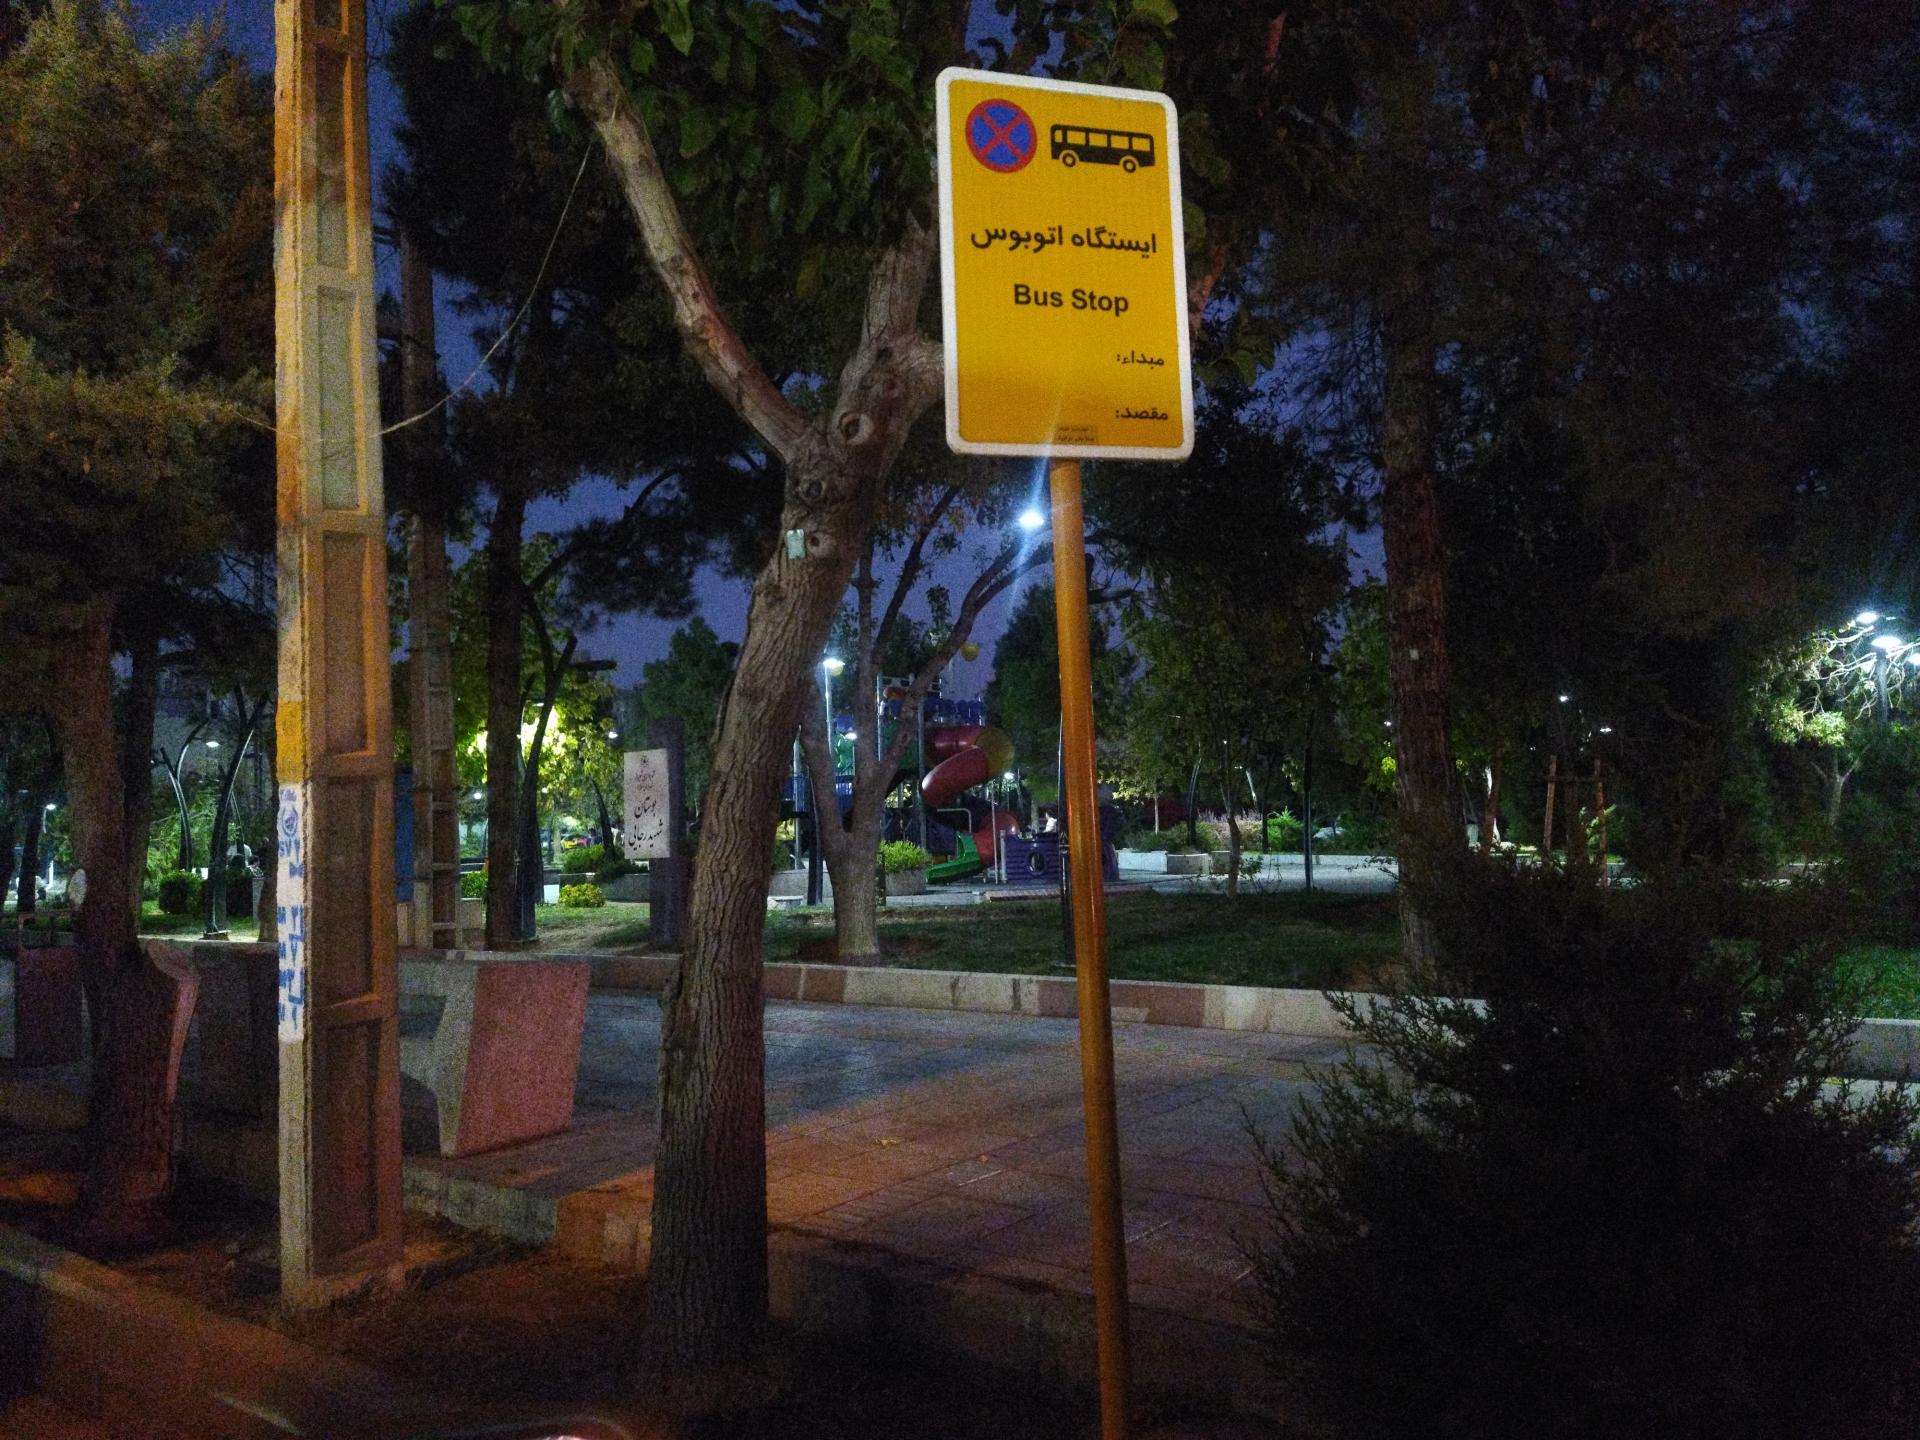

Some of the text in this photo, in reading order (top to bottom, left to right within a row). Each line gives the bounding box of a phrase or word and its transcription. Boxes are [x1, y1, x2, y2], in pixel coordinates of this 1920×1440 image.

[970, 225, 1157, 259] ایستگاه اتوبوس
[1014, 283, 1129, 317] Bus Stop
[1115, 407, 1169, 421] مقصد:
[633, 796, 657, 819] بوستان
